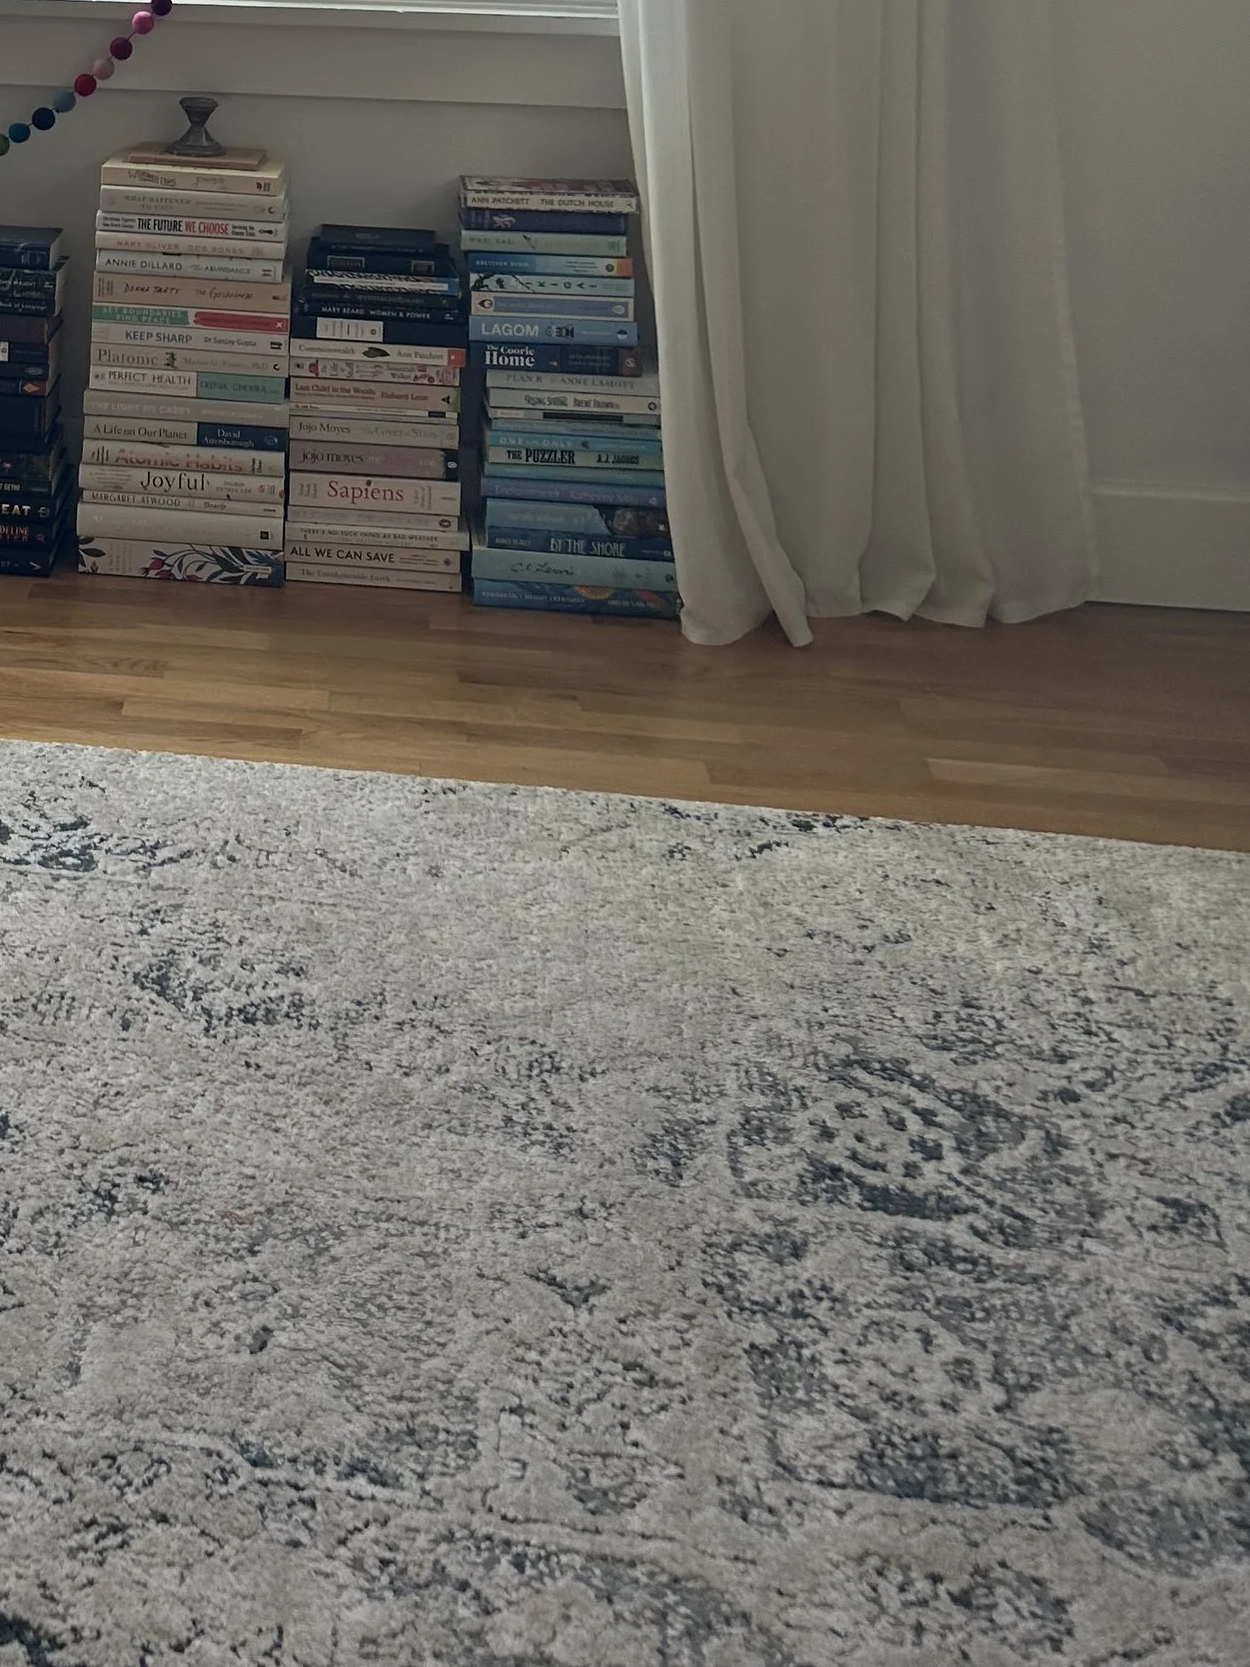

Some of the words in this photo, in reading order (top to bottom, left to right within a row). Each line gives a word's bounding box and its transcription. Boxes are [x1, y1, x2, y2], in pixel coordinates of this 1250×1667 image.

[540, 198, 555, 206] THE
[558, 199, 585, 207] DUTCH
[588, 200, 614, 208] HOUSE
[138, 218, 152, 230] THE
[153, 219, 183, 233] FUTURE
[185, 221, 197, 233] WE
[198, 222, 230, 236] CHOOSE
[116, 240, 143, 249] MARY
[145, 241, 180, 251] OLIVER
[105, 258, 136, 268] ANNIE
[140, 260, 183, 271] DILLARD
[321, 305, 341, 314] MARY
[343, 307, 365, 315] BEARD
[368, 309, 396, 318] WOMEN
[406, 311, 431, 319] POWER
[147, 315, 171, 325] PEACE
[126, 330, 153, 342] KEEP
[156, 332, 192, 344] SHARP
[481, 323, 540, 337] LAGOM
[213, 336, 234, 347] Sanjay
[236, 338, 256, 348] Gupta
[299, 344, 356, 355] Commonwealth
[486, 344, 499, 352] The
[500, 346, 535, 357] Coorie
[98, 348, 158, 368] Platonic
[485, 351, 536, 368] Home
[108, 370, 147, 382] PERFECT
[152, 373, 191, 385] HEALTH
[506, 374, 533, 383] PLAN
[560, 377, 588, 386] ANNE
[591, 378, 635, 390] LAMOTT
[295, 383, 310, 392] Last
[311, 384, 331, 393] Child
[332, 385, 338, 393] in
[339, 386, 352, 394] the
[353, 386, 376, 395] Woods
[94, 424, 102, 434] A
[103, 425, 123, 435] Life
[138, 427, 157, 437] Our
[158, 428, 188, 440] Planet
[217, 429, 241, 439] David
[114, 448, 180, 468] Atomic
[186, 452, 243, 473] Habits
[507, 449, 522, 460] THE
[525, 448, 576, 464] PUZZLER
[140, 470, 206, 493] Joyful
[91, 491, 136, 504] MARGARET
[141, 495, 181, 507] ATWOOD
[327, 480, 405, 505] Sapiens
[290, 546, 311, 557] ALL
[315, 547, 332, 558] WE
[336, 549, 362, 560] CAN
[367, 551, 395, 563] SAVE
[550, 537, 563, 553] BY
[566, 538, 587, 555] THE
[591, 541, 626, 558] SHORE
